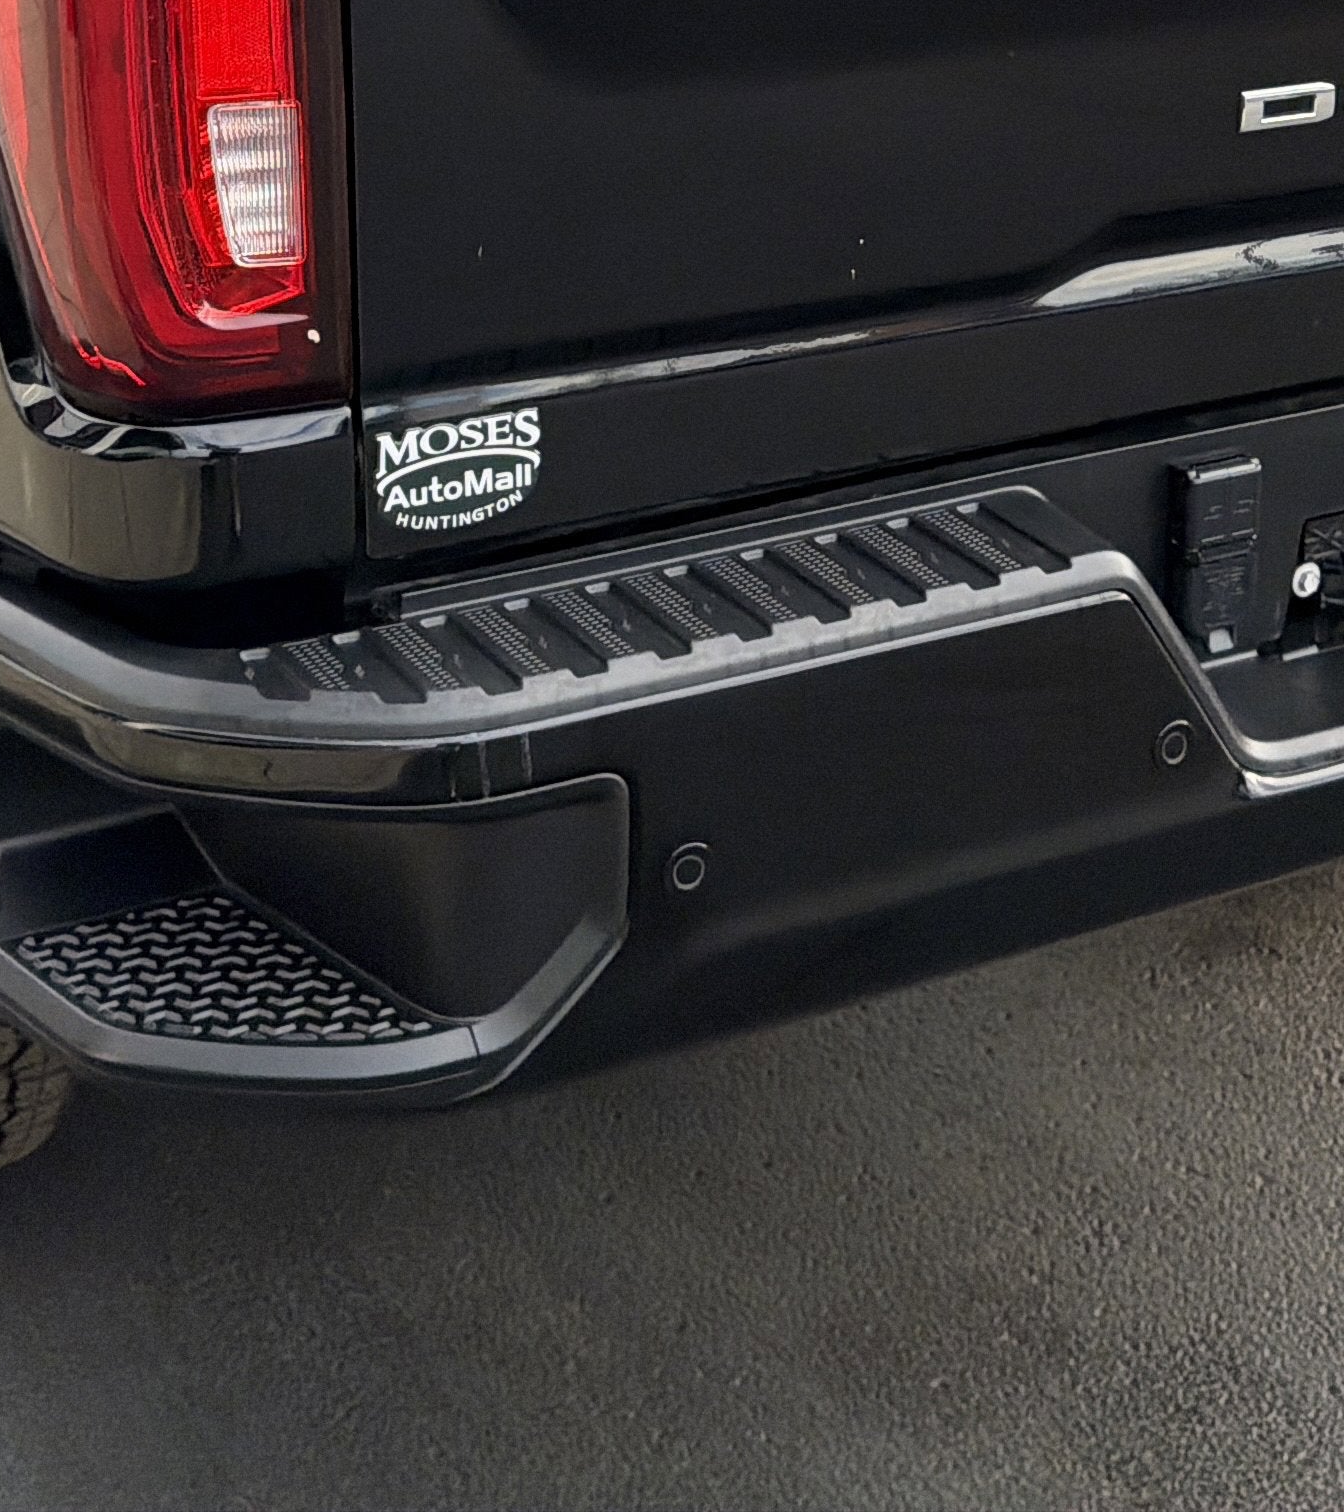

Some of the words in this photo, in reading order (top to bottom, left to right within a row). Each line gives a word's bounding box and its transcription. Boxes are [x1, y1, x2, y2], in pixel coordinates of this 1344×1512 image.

[375, 407, 541, 480] MOSES
[383, 463, 533, 513] AutoMall
[395, 489, 524, 531] HUNTINGTON
